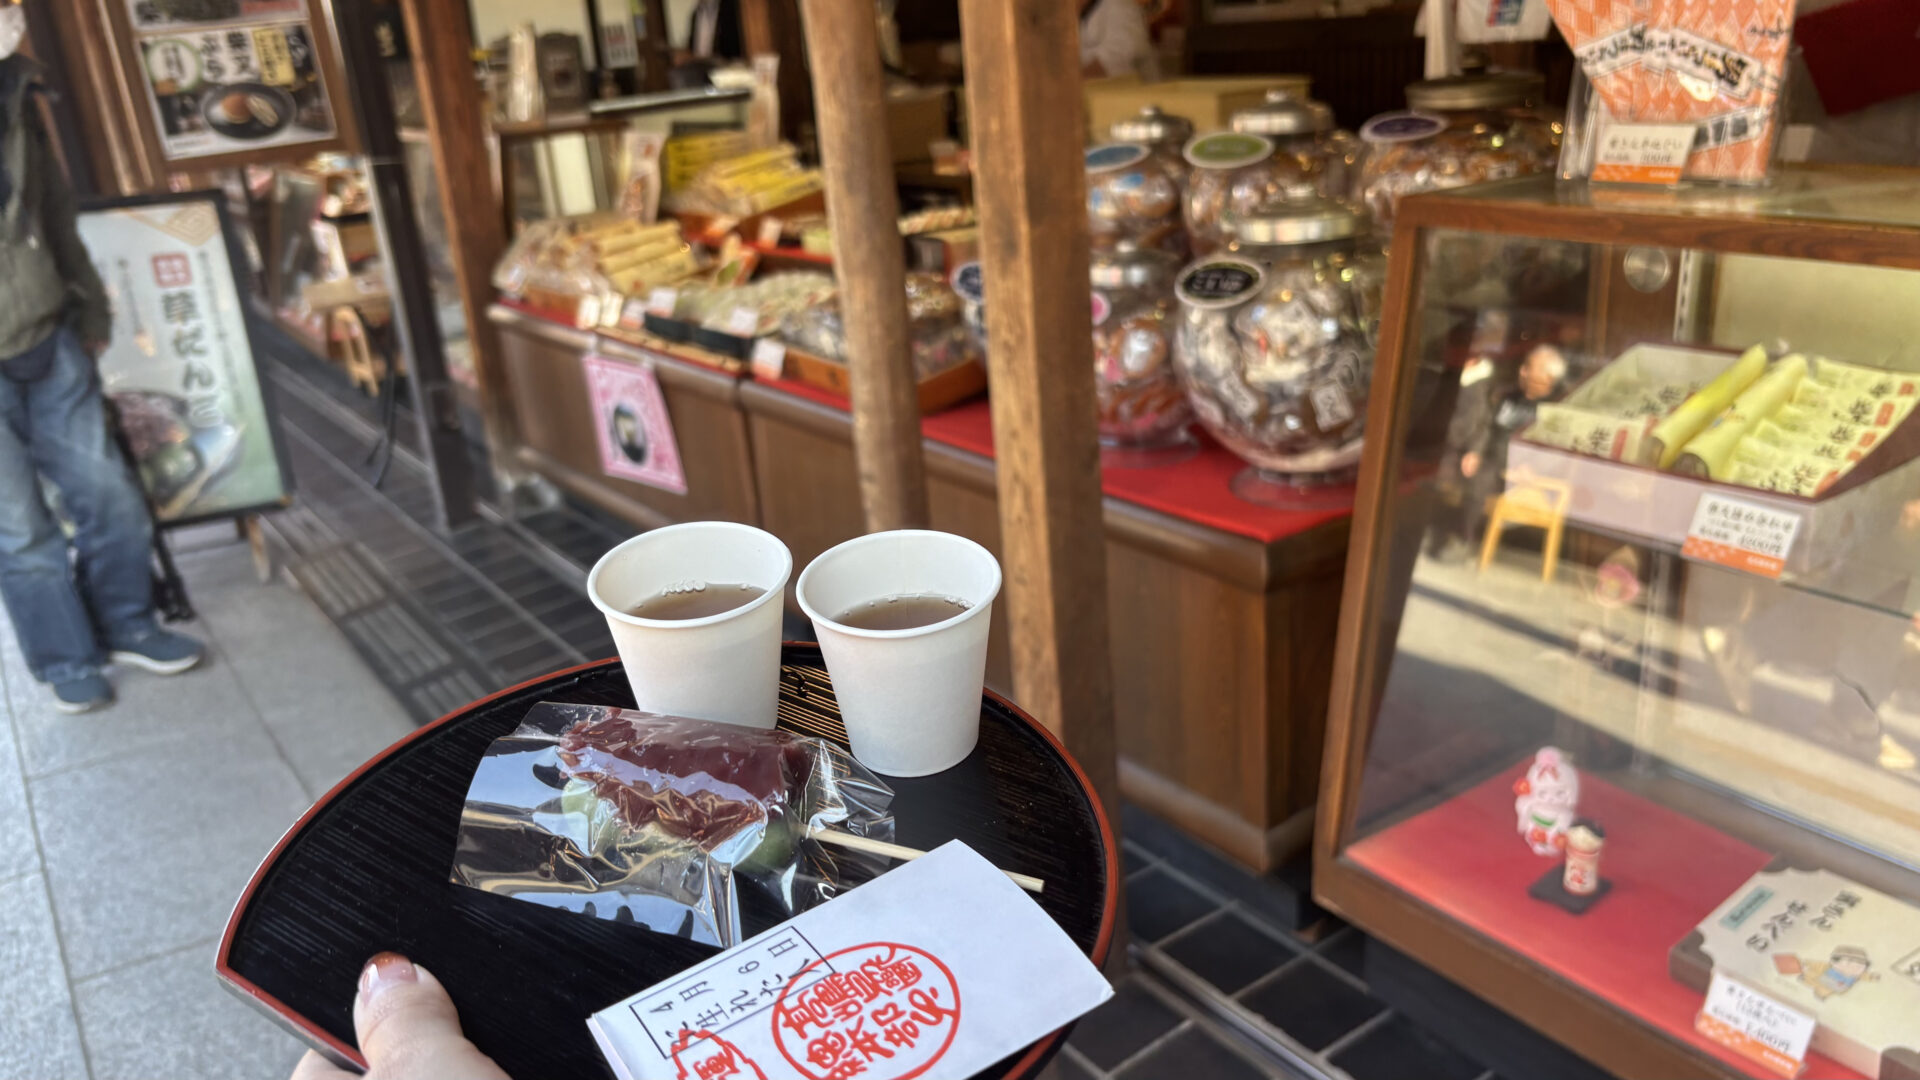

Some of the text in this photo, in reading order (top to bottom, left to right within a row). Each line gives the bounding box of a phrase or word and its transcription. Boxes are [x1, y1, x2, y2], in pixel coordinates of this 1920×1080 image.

[665, 958, 821, 1046] に生れた人
